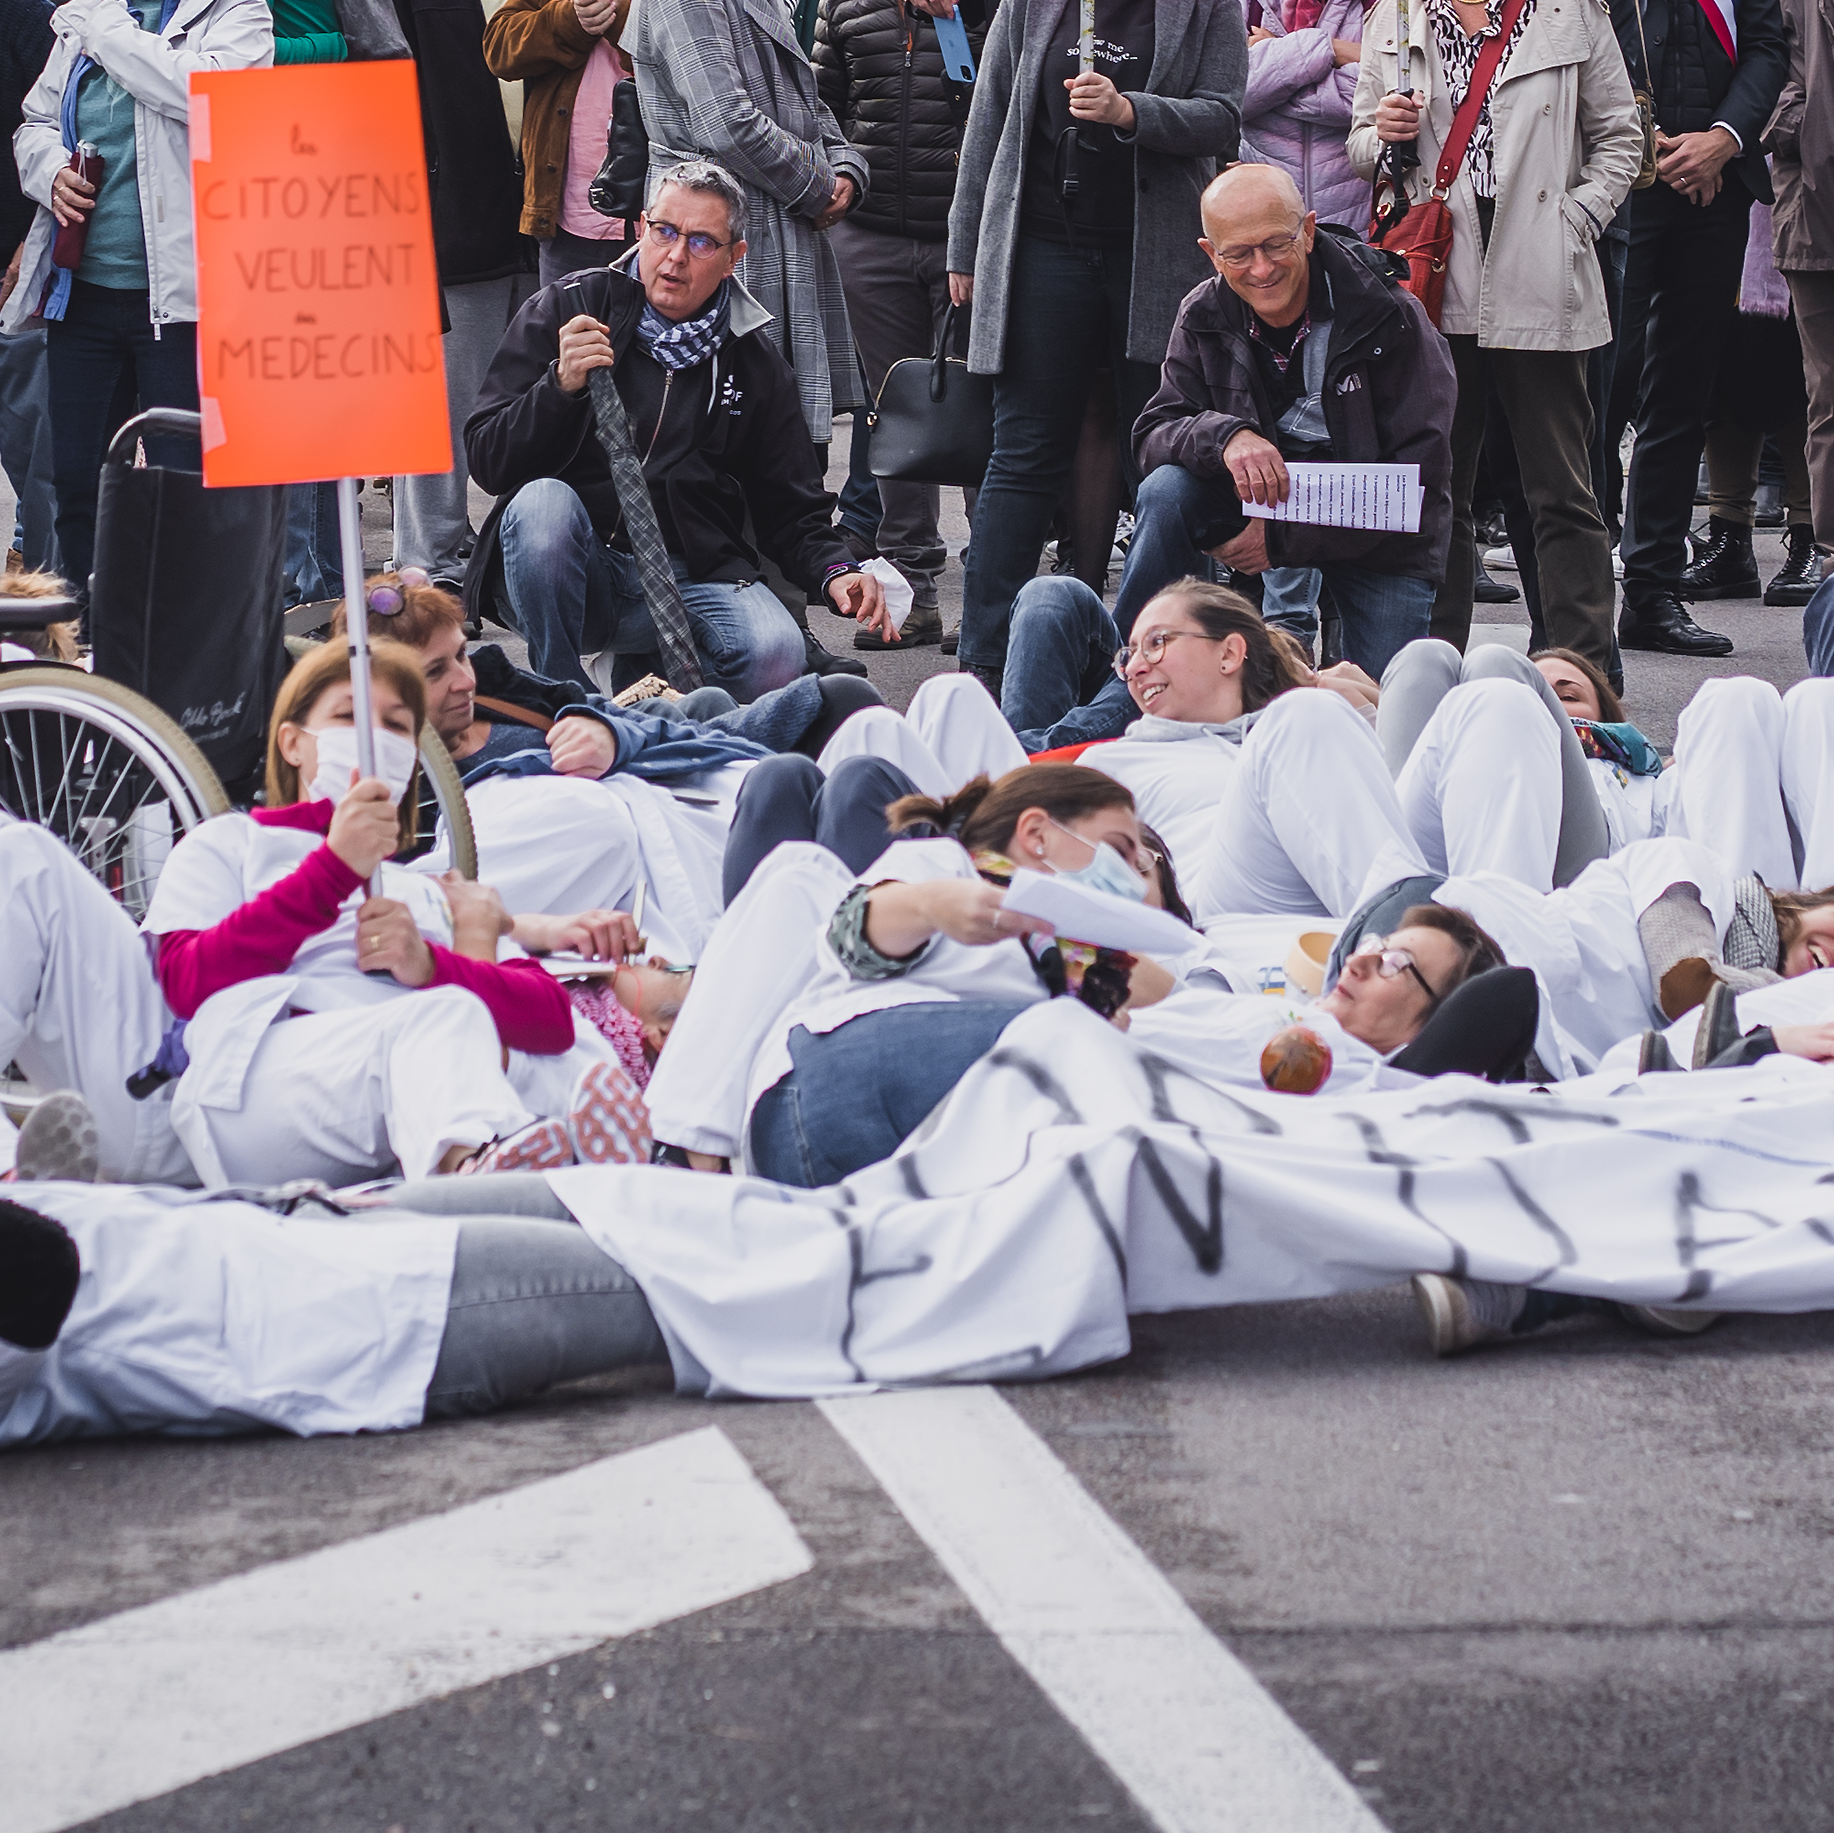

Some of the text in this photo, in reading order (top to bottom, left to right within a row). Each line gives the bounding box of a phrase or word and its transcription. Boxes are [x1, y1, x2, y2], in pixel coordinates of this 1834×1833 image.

[202, 171, 421, 220] CITOYENS
[234, 242, 415, 292] VEULENT
[217, 331, 442, 380] MEDECINS
